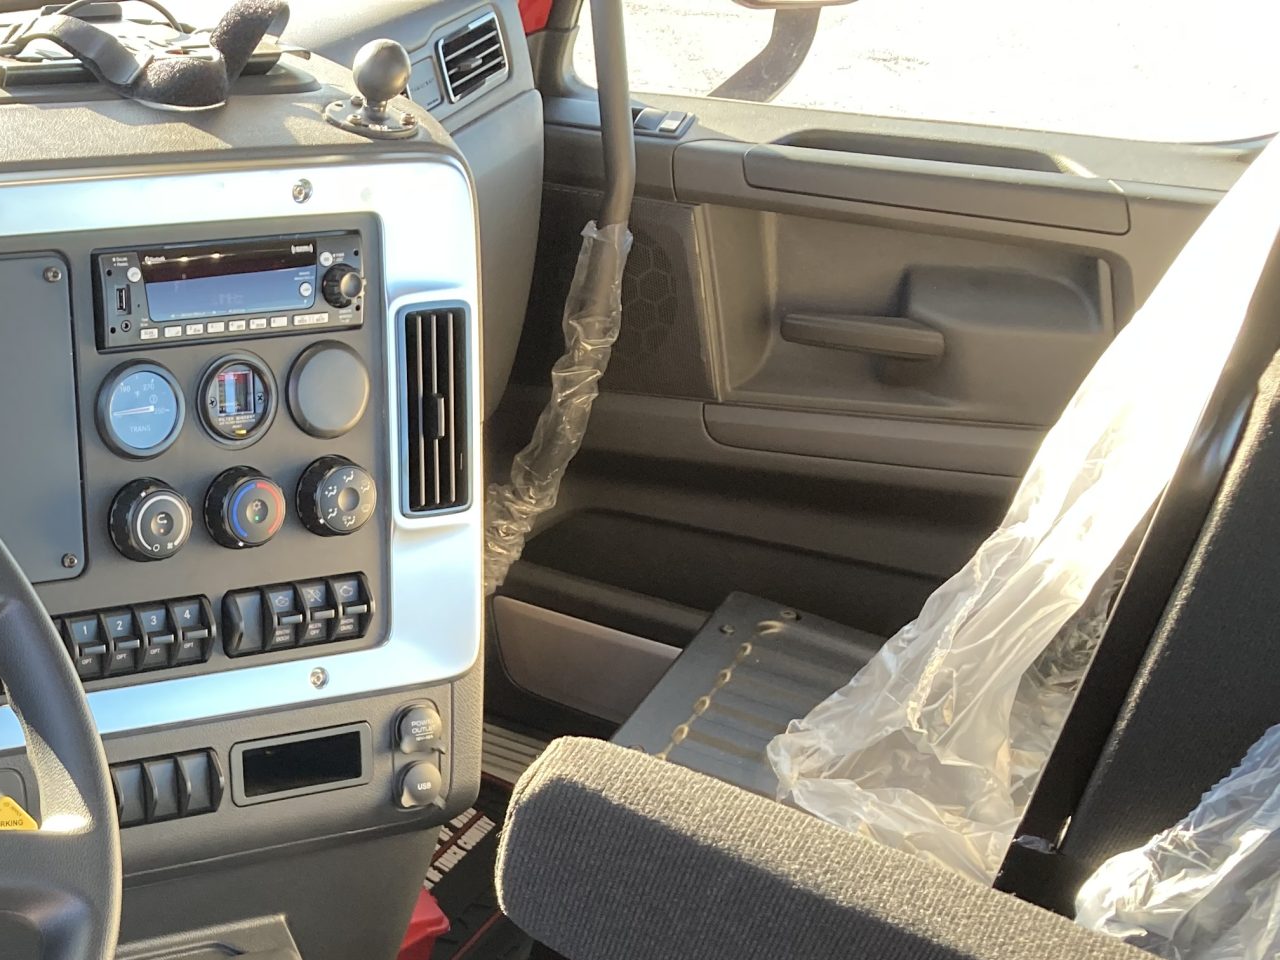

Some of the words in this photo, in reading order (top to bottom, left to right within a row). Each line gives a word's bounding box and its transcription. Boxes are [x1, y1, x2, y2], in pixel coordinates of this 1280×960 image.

[183, 610, 191, 619] 4
[150, 616, 157, 625] 3
[116, 621, 123, 630] 2
[82, 626, 87, 635] 1
[417, 782, 431, 790] USB
